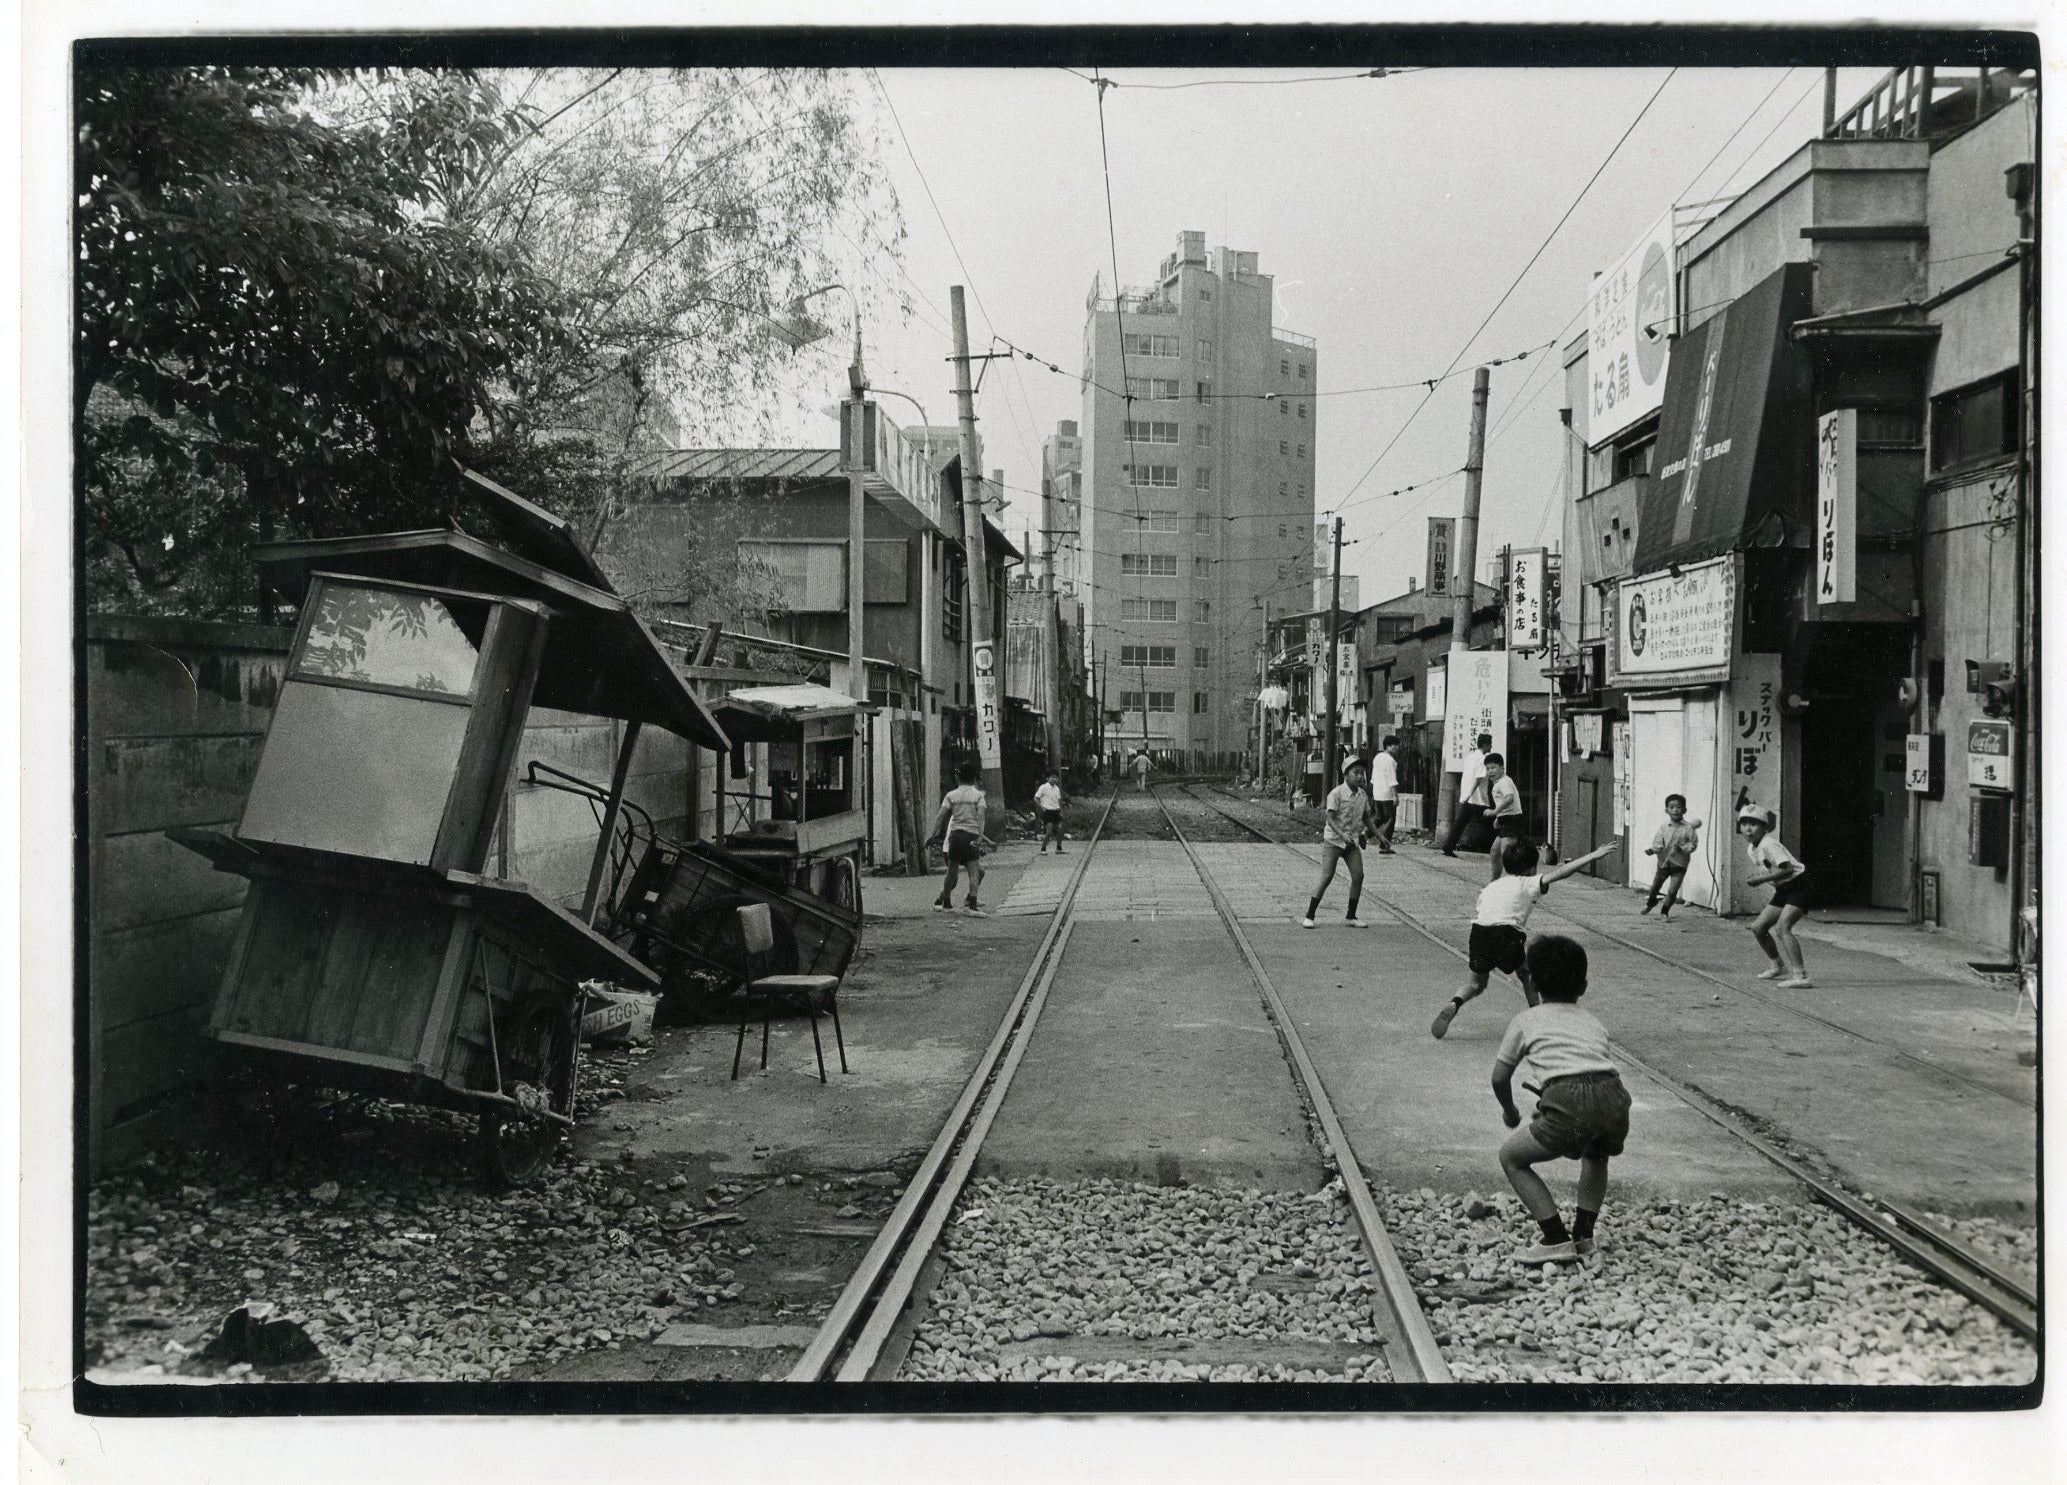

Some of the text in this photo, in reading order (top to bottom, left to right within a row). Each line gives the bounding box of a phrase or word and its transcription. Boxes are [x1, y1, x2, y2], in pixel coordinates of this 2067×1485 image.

[1758, 682, 1773, 752] スナックバー
[607, 999, 640, 1027] EGGS
